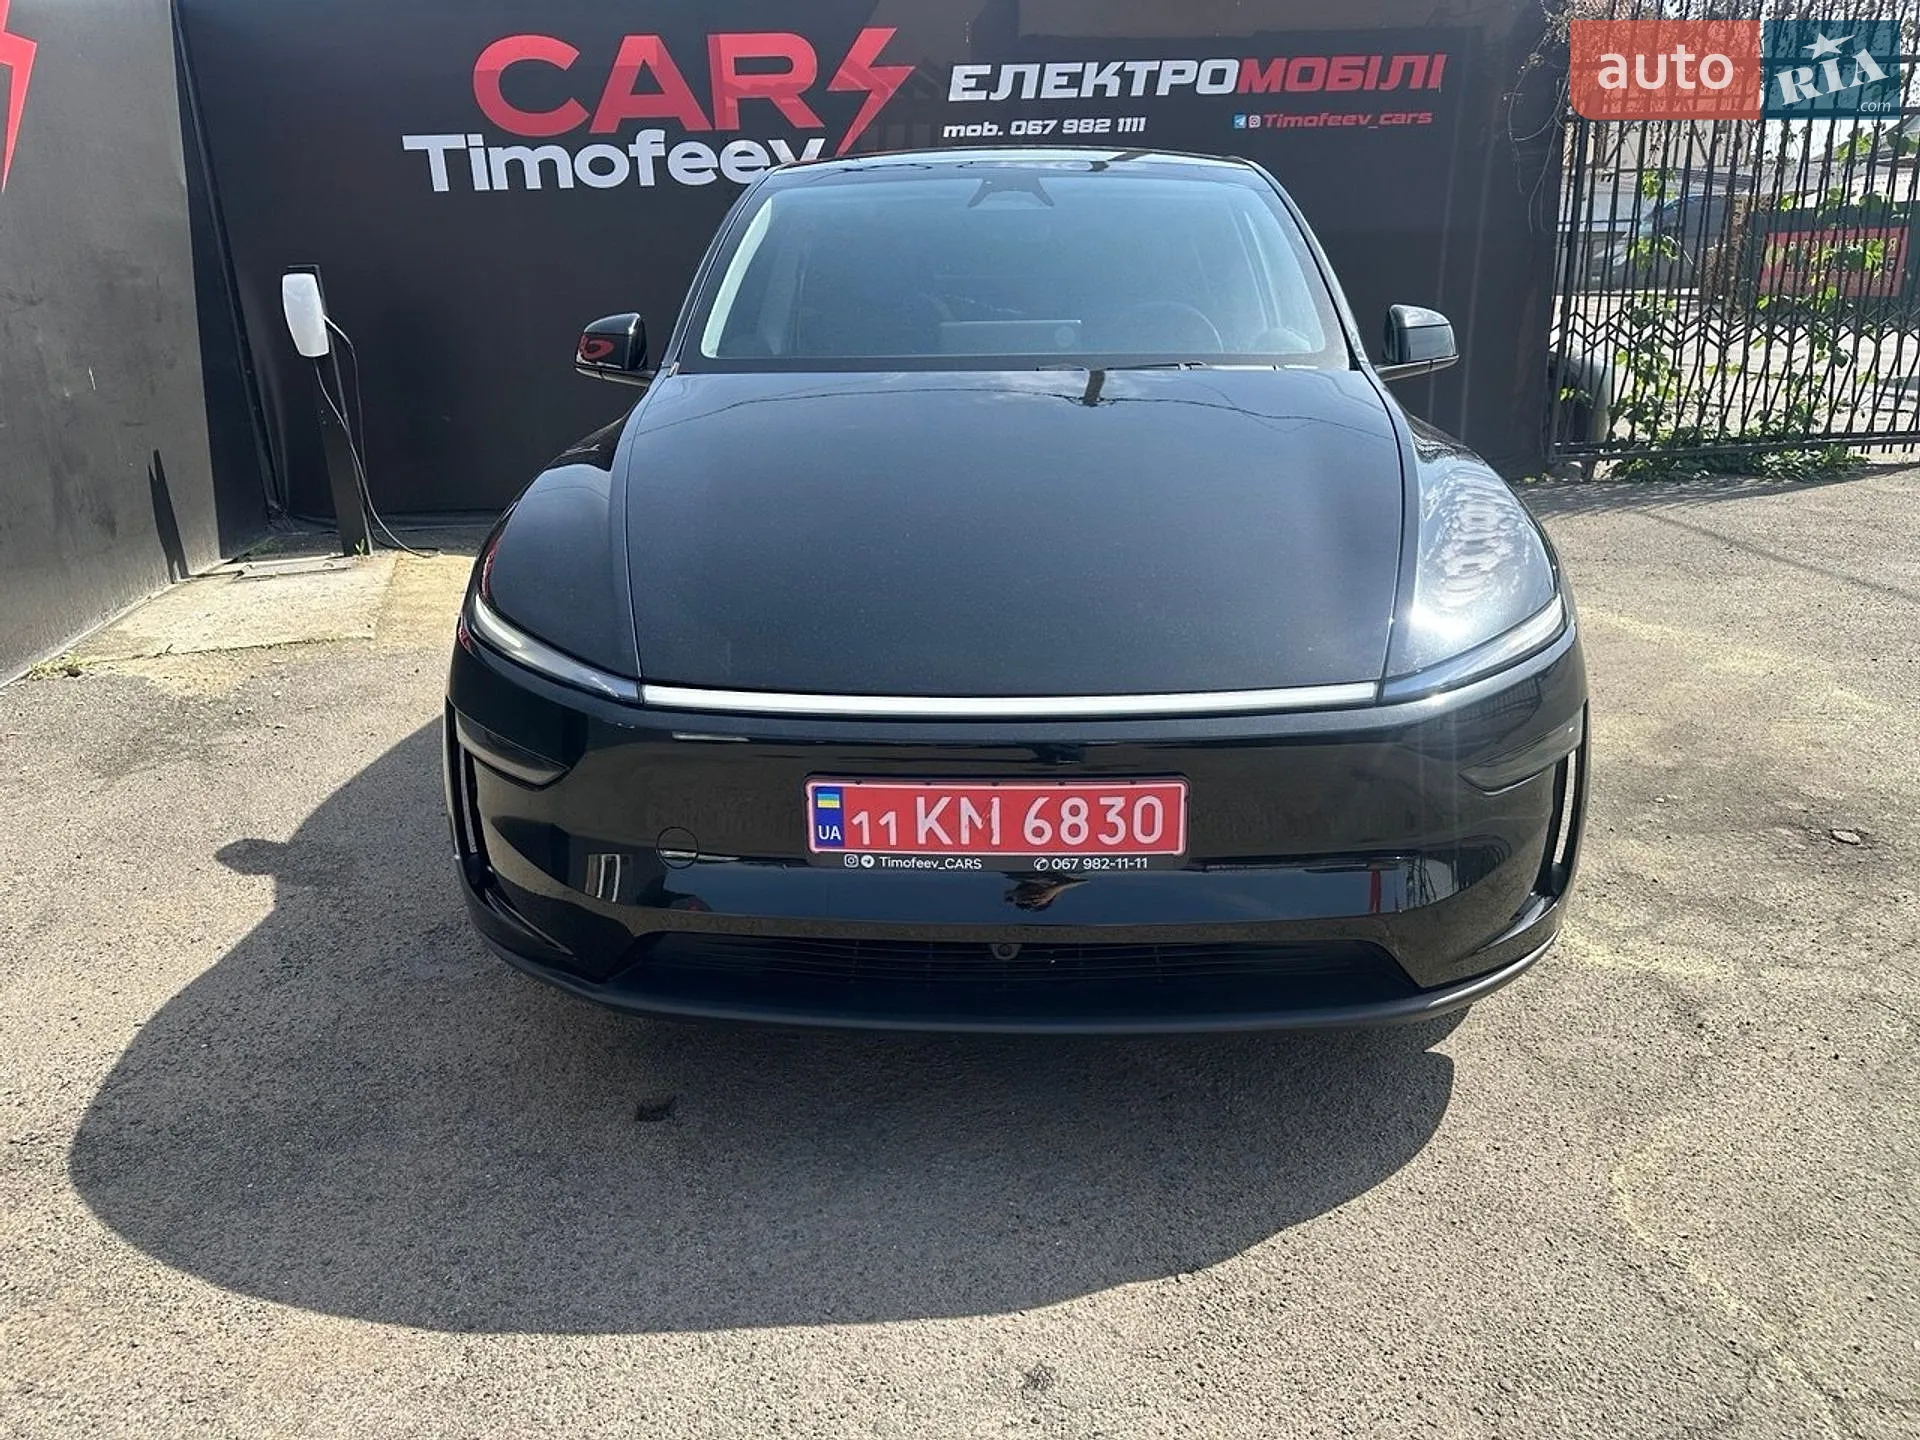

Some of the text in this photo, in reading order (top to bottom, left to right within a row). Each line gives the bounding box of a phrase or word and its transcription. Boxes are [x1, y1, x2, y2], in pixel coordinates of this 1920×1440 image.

[948, 53, 1447, 102] ЕЛЕКТРОМОБІЛІ
[943, 117, 1147, 138] mob. 067 982 1111
[1263, 112, 1433, 129] Timofeev_cars
[851, 795, 1164, 846] 11 KM 6830
[818, 825, 842, 841] UA
[879, 856, 982, 870] Timofeev_CARS
[1051, 857, 1149, 870] 067 982-11-11
